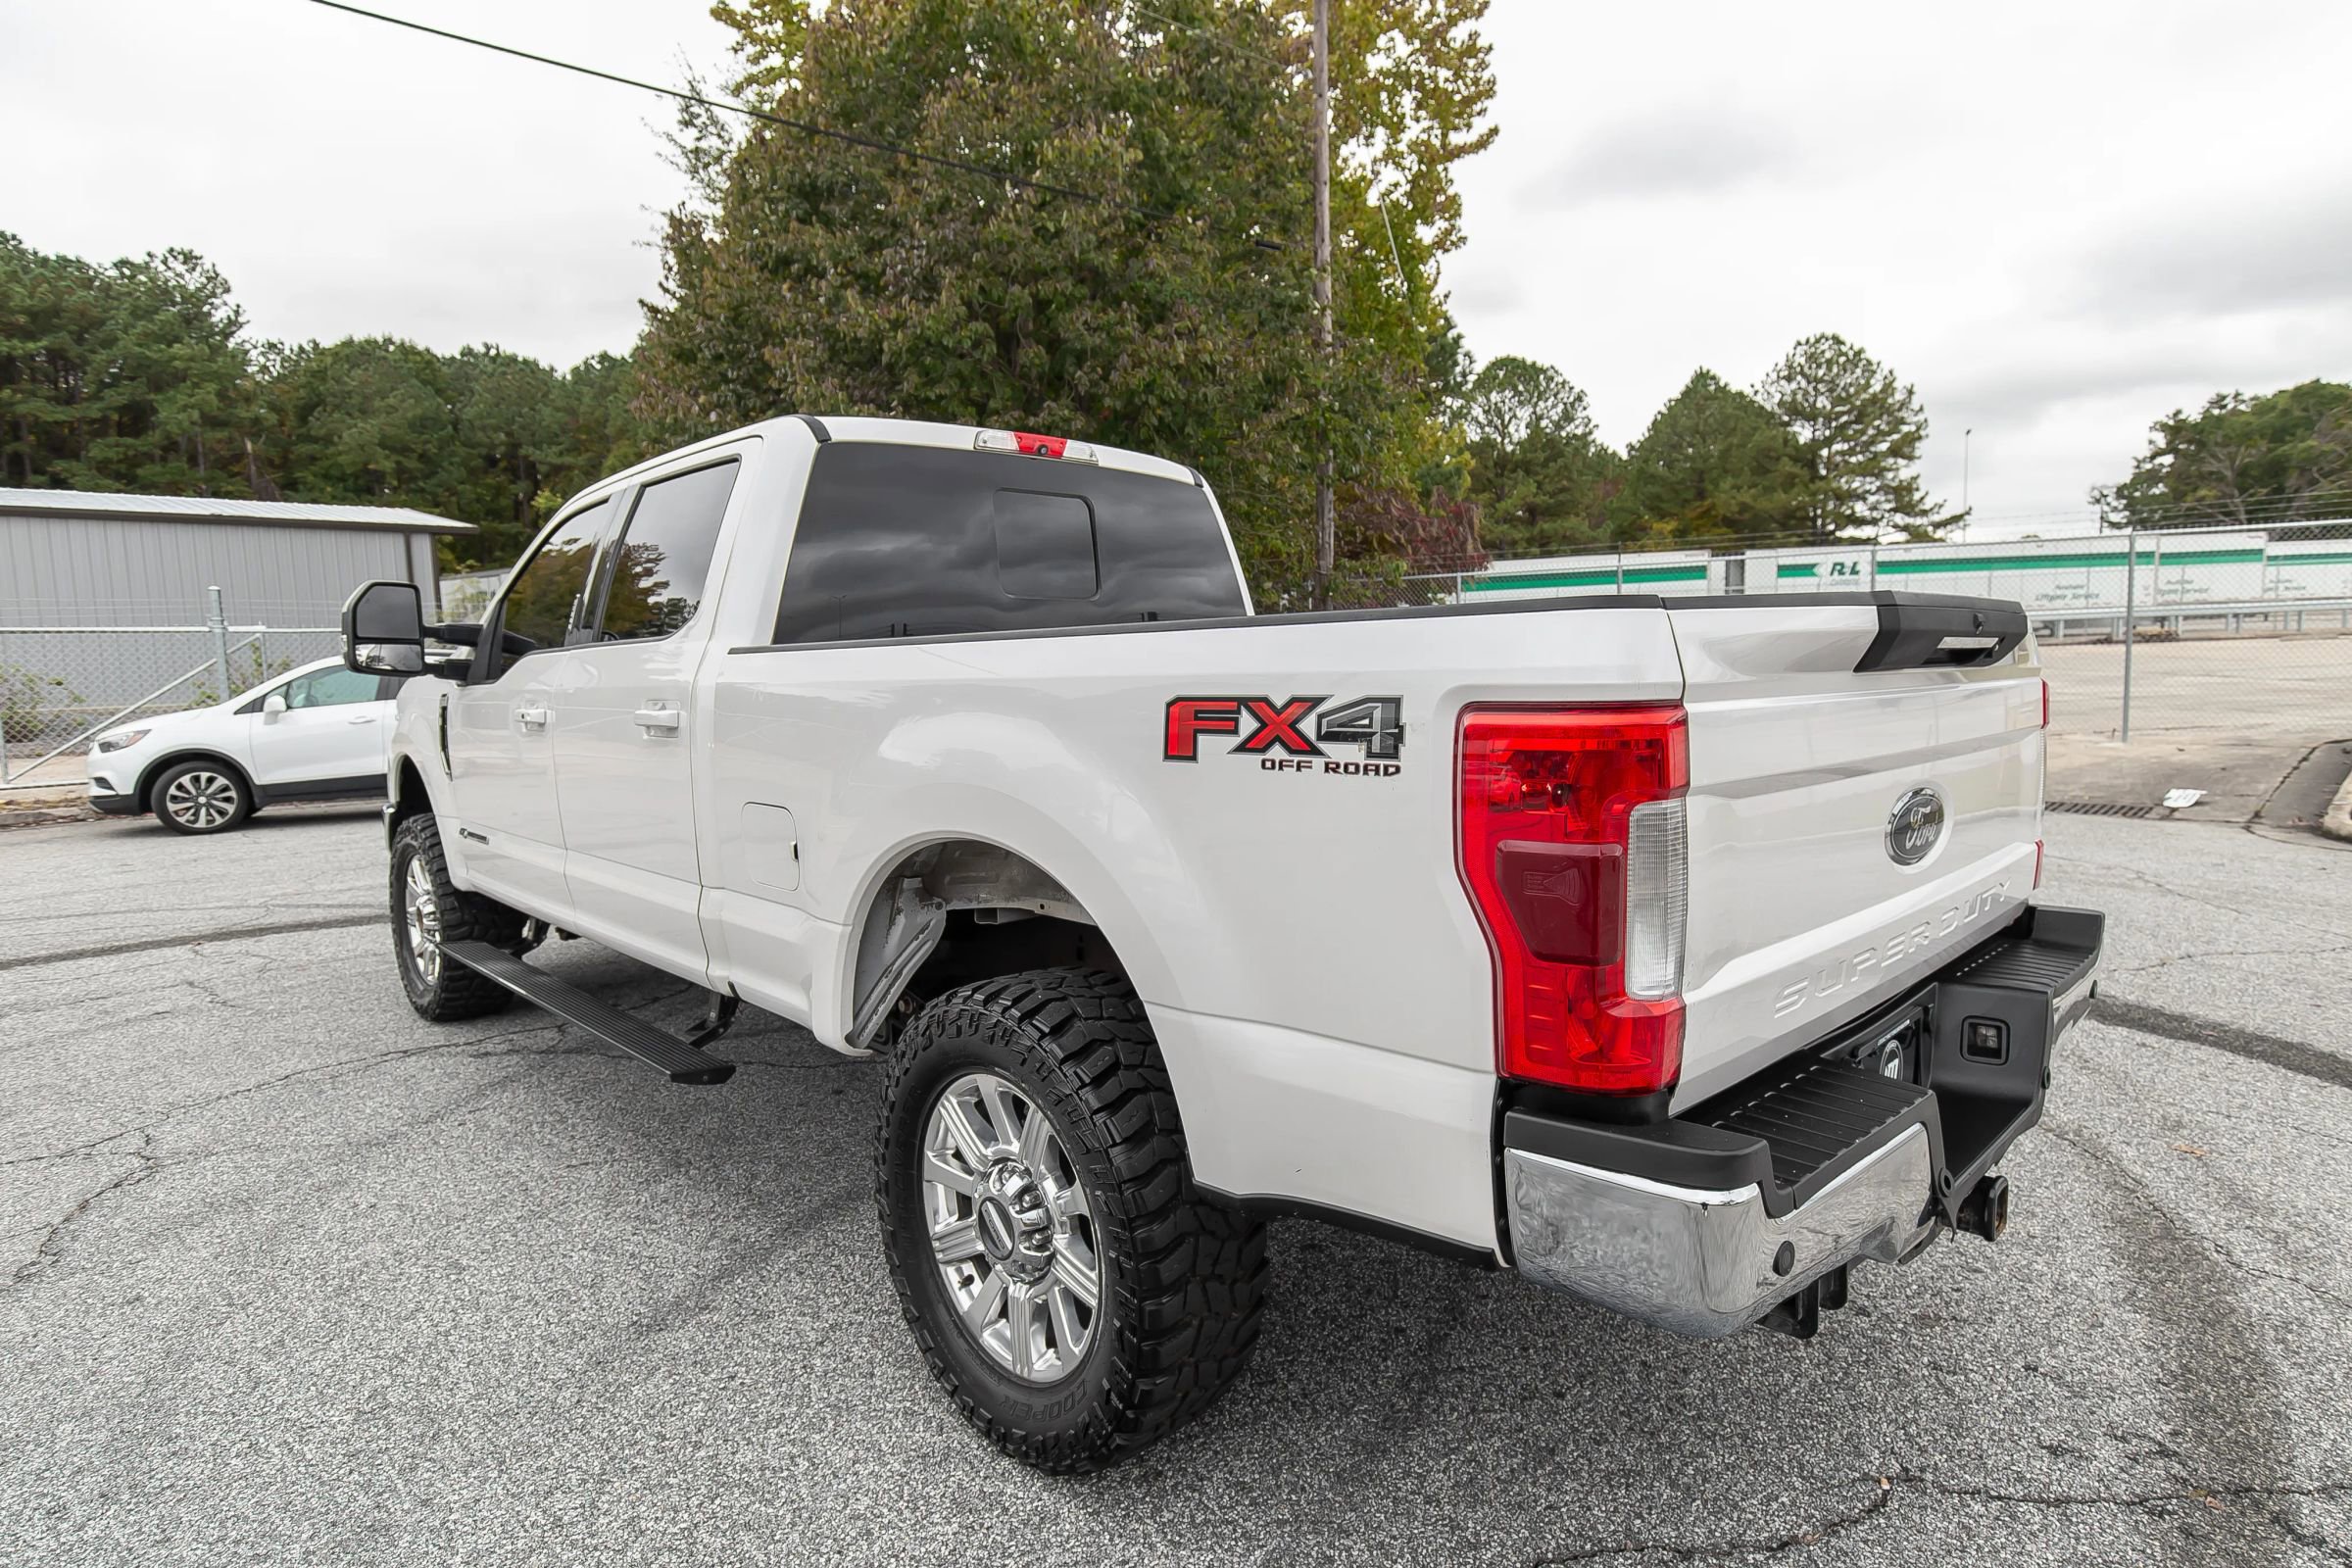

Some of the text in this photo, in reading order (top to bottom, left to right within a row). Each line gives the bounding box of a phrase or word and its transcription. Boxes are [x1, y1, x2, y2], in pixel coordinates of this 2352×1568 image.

[1163, 695, 1405, 762] FX4
[1260, 758, 1402, 777] OFF ROAD
[1774, 880, 2010, 1018] SUPER DUTY
